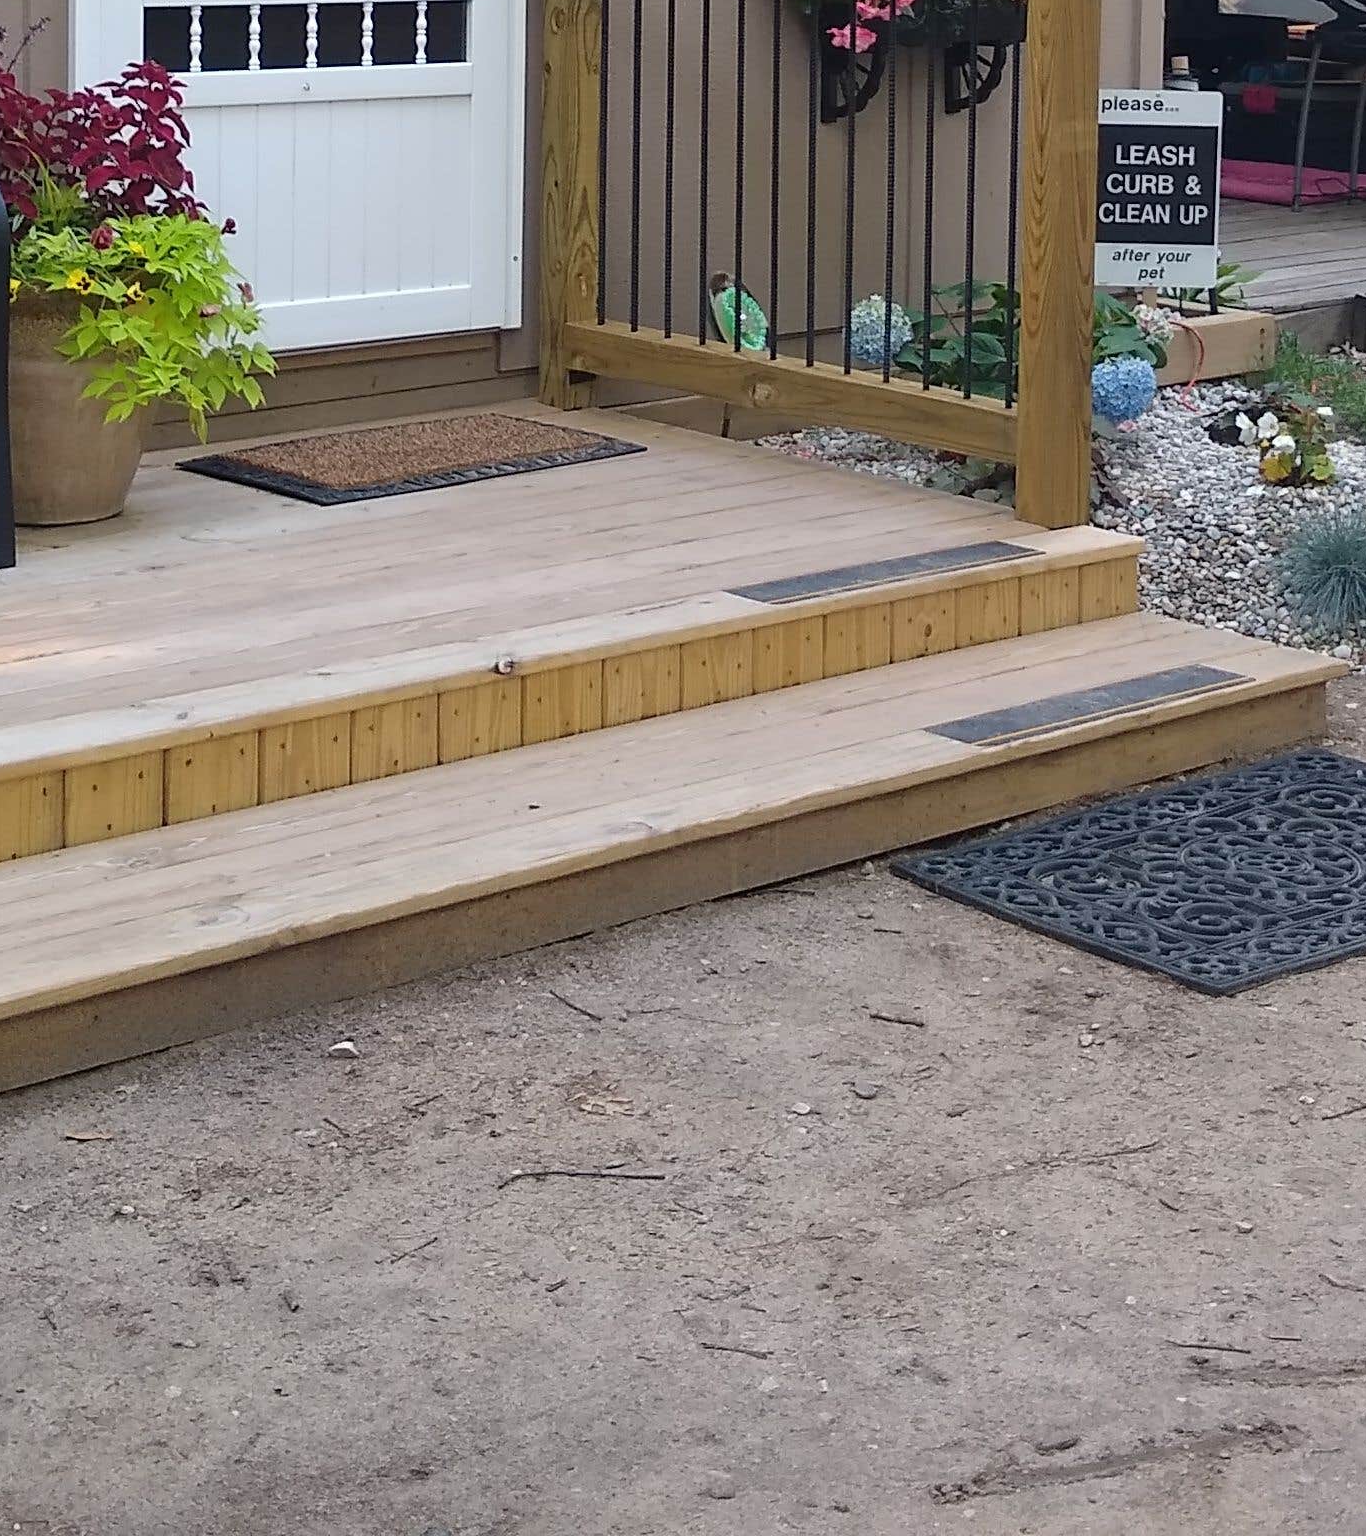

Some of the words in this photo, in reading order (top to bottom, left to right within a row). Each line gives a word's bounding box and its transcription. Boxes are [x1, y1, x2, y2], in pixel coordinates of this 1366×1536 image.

[1101, 95, 1180, 114] please...
[1115, 144, 1195, 167] LEASH
[1106, 173, 1174, 195] CURB
[1185, 173, 1202, 195] &
[1098, 202, 1171, 225] CLEAN
[1179, 203, 1209, 226] UP
[1112, 248, 1151, 263] after
[1156, 250, 1191, 266] your
[1138, 265, 1165, 283] pet
